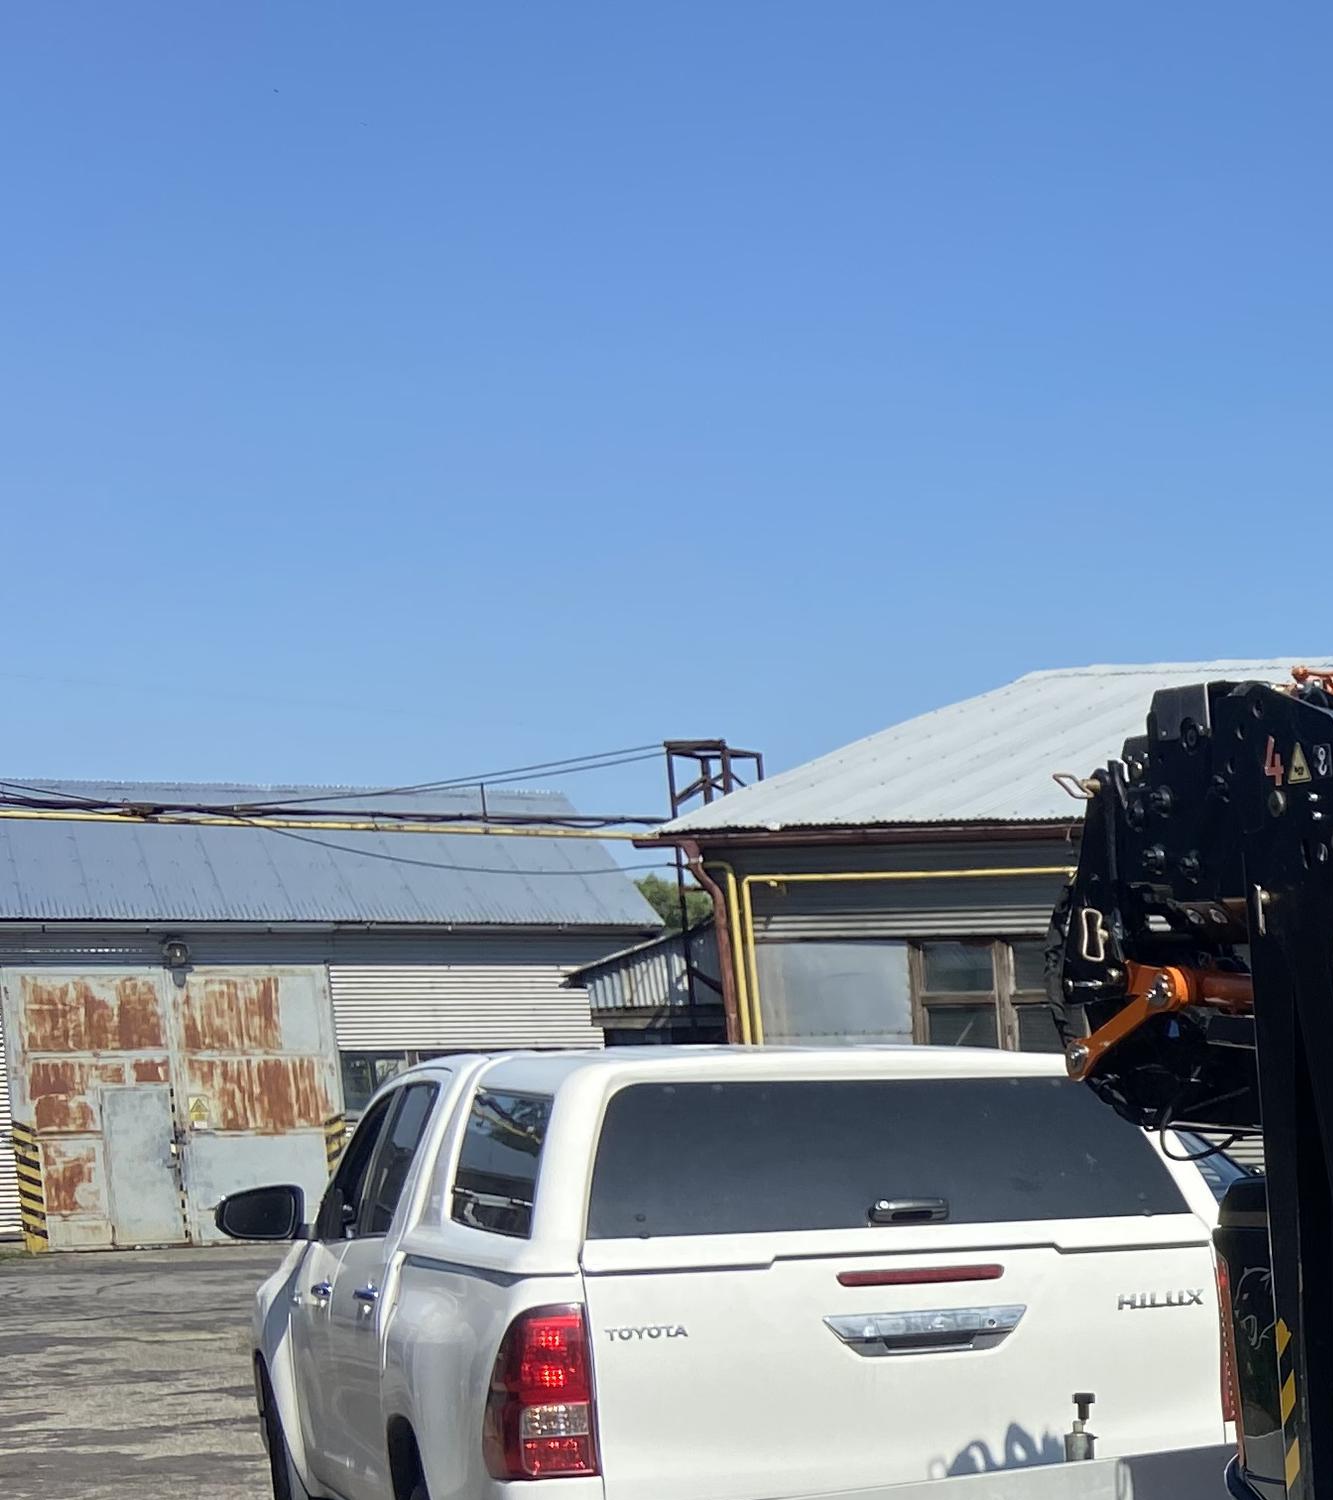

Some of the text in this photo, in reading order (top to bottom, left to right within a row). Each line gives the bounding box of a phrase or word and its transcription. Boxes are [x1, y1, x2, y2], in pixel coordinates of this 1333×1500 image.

[1264, 735, 1284, 786] 4
[1118, 1288, 1204, 1310] HILUX
[604, 1325, 688, 1341] TOYOTA
